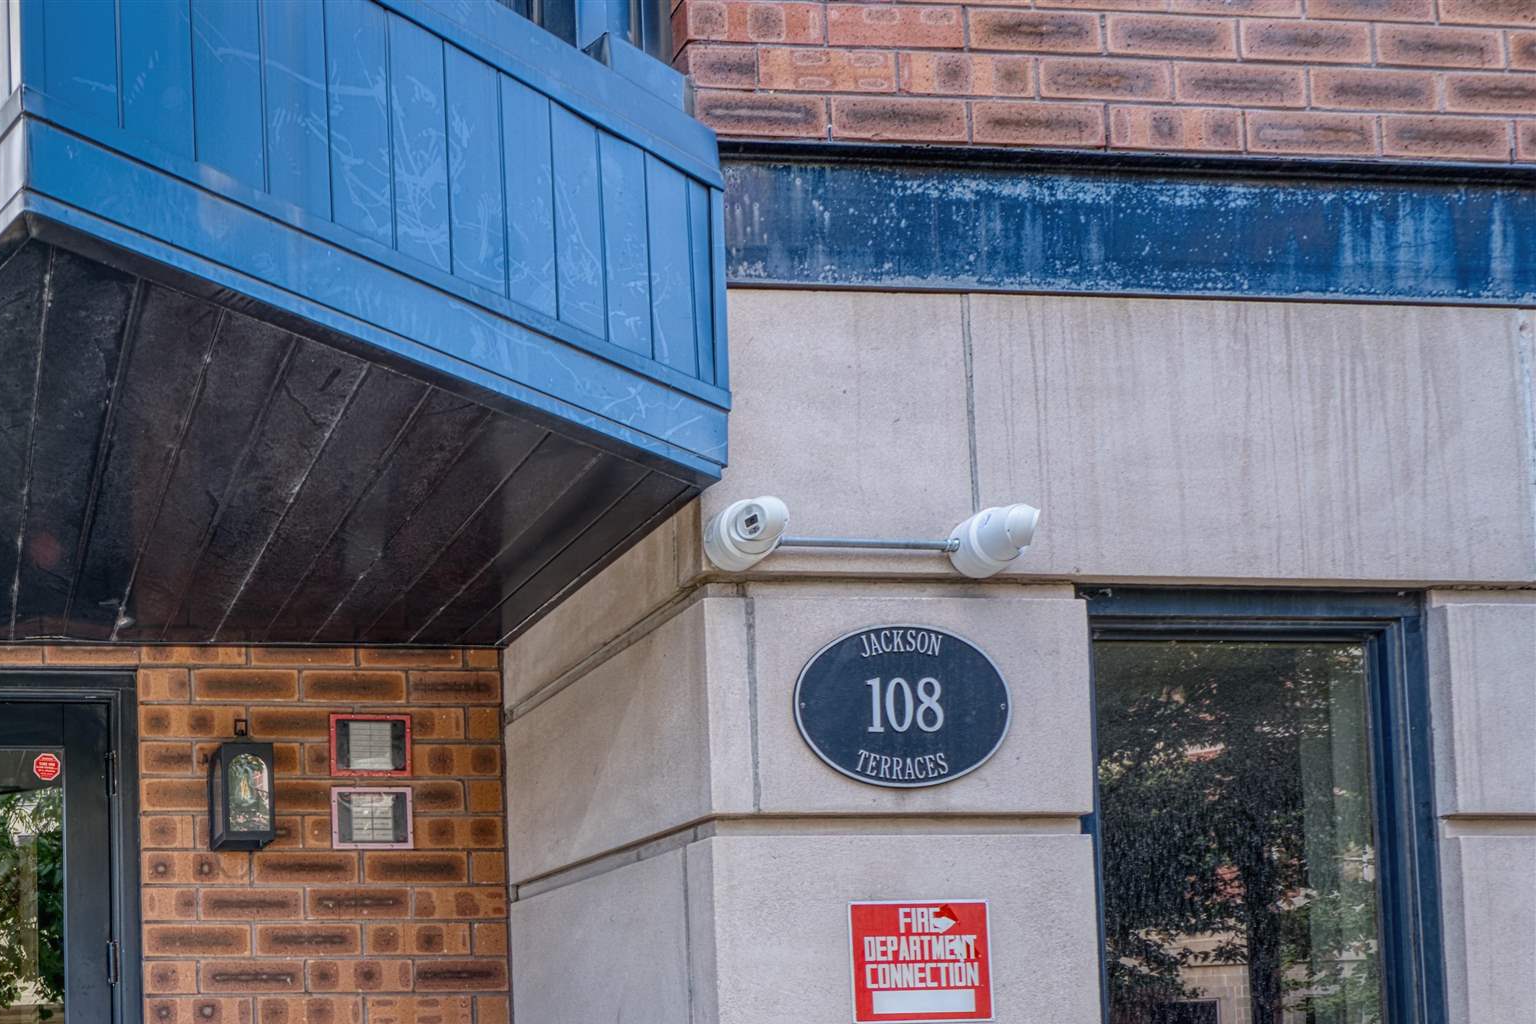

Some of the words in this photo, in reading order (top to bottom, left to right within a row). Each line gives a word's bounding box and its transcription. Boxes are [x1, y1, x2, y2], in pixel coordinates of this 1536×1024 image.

[860, 629, 943, 658] JACKSON
[866, 677, 945, 733] 108
[855, 750, 949, 780] TERRACES
[898, 907, 942, 933] FIRE
[863, 934, 977, 962] DEPARTMENT
[865, 962, 980, 989] CONNECTION
